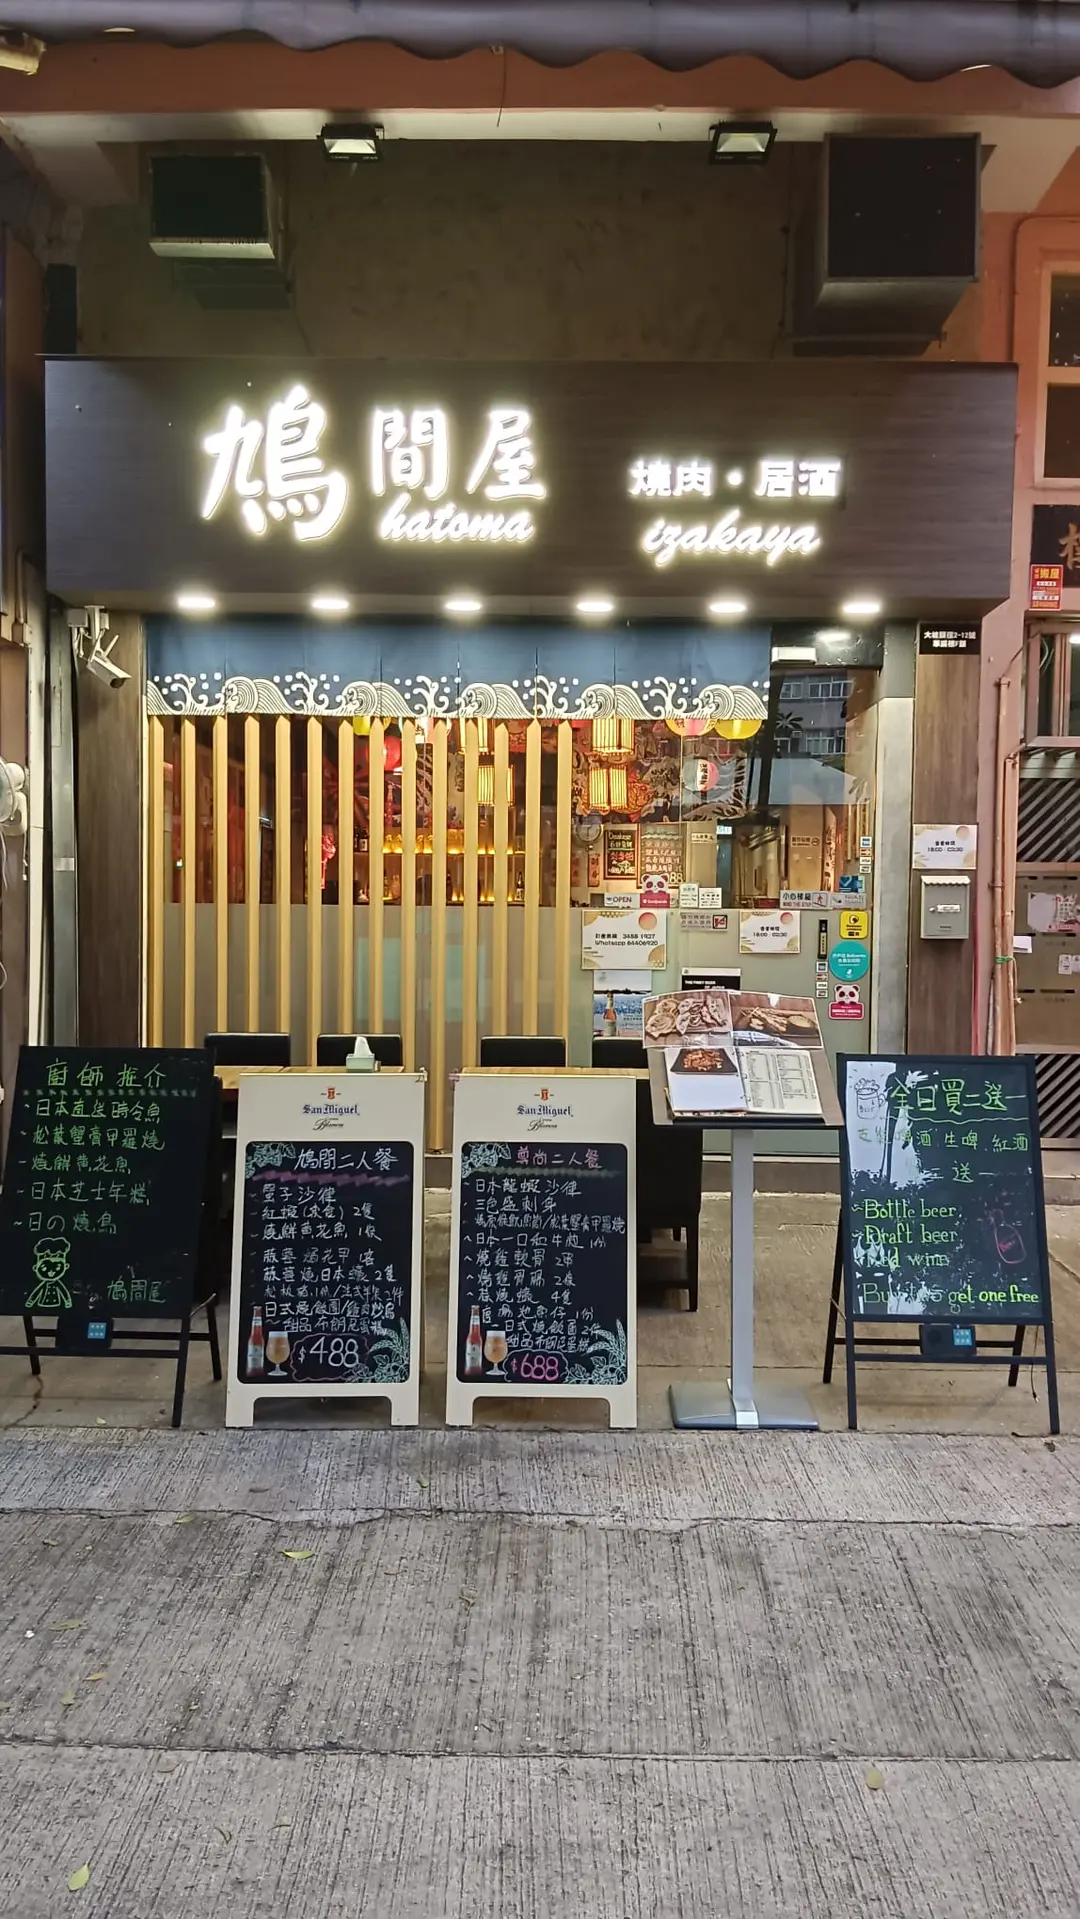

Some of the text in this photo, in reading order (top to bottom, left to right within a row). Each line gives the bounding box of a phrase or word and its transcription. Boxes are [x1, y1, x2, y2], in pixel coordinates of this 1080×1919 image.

[204, 385, 545, 541] 鳩間屋
[380, 493, 535, 543] hatoma
[643, 510, 820, 567] izakaya
[783, 892, 811, 900] 小心梯級
[46, 1058, 166, 1088] 廚師推介
[303, 1103, 359, 1117] San Miguel
[517, 1104, 573, 1118] San Miguel
[864, 1199, 957, 1219] Bottle beer
[921, 1223, 959, 1243] beer
[978, 1290, 1006, 1301] one
[1009, 1284, 1039, 1303] free
[298, 1336, 359, 1368] $488
[510, 1353, 559, 1381] $688
